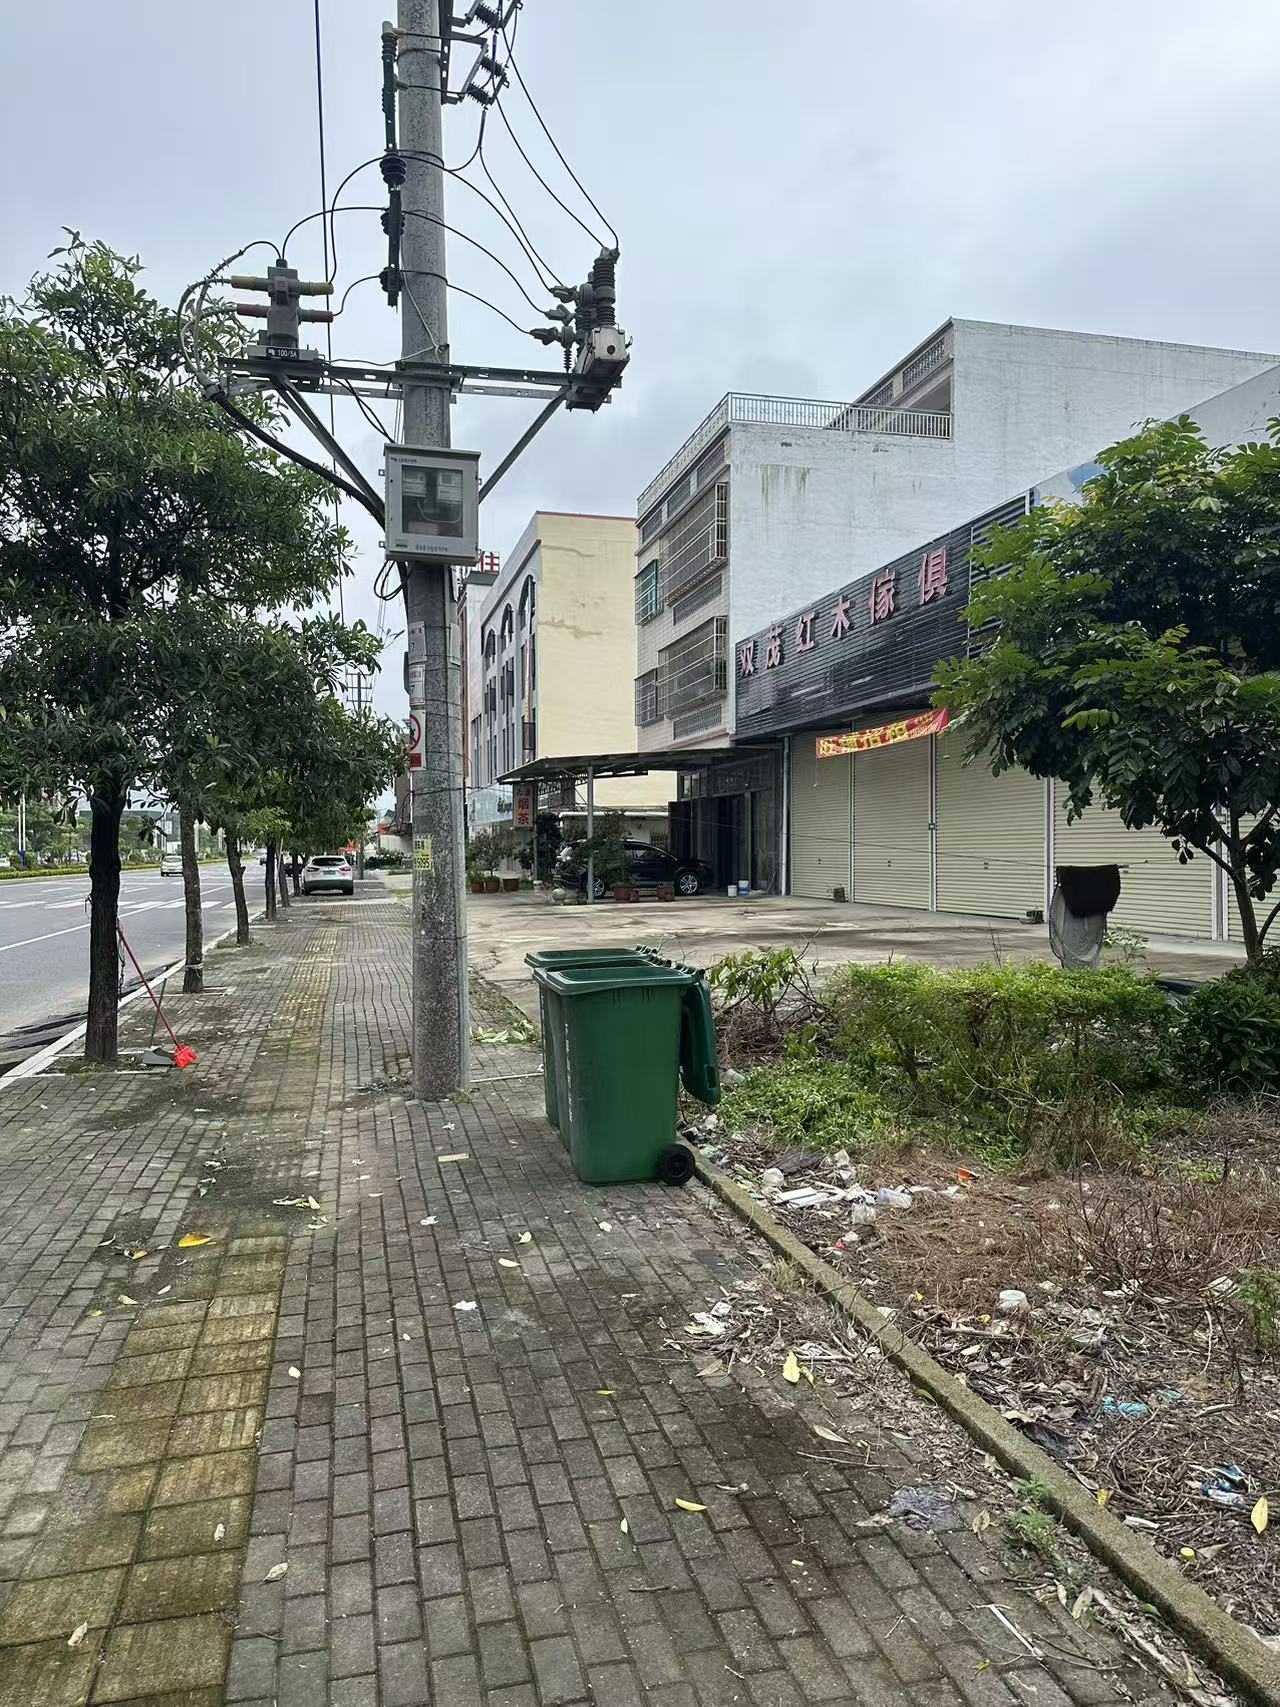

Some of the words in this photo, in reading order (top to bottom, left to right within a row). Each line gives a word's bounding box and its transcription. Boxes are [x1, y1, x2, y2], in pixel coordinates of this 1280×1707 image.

[739, 544, 948, 677] 双茂红木傢俱
